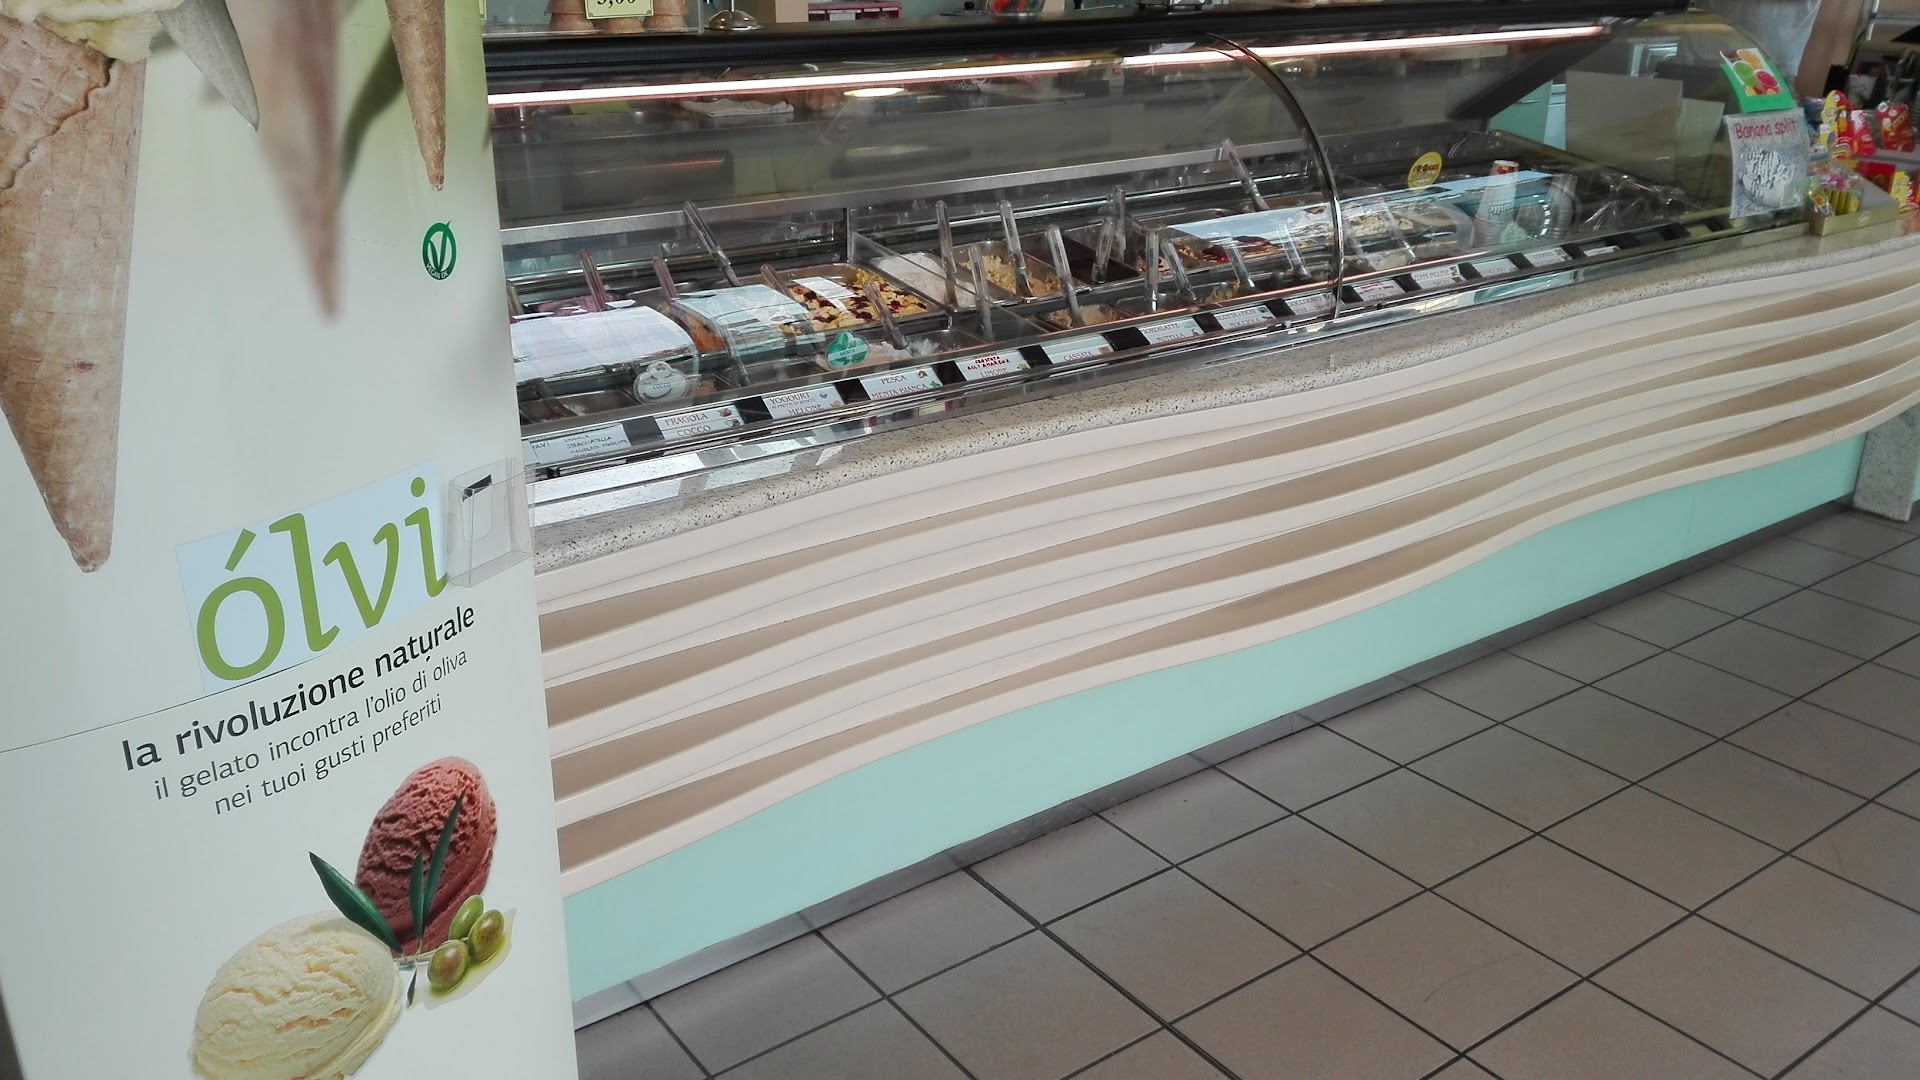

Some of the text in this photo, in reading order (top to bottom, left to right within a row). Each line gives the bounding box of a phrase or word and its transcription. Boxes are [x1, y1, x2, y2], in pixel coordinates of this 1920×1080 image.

[1735, 117, 1797, 140] Banana split
[426, 262, 441, 279] VEGAN
[1156, 332, 1186, 344] NUTELLA
[840, 348, 856, 357] MENTA
[1063, 351, 1094, 362] CASSATA
[980, 367, 1009, 378] LIMONE
[652, 381, 671, 390] COCCO
[880, 375, 908, 385] PESCA
[768, 391, 811, 405] YOGOURT
[871, 383, 929, 400] MENTA BIANCA
[787, 403, 824, 417] MELONE
[664, 412, 709, 427] FRAGOLA
[676, 424, 712, 437] COCCO
[566, 435, 612, 449] STRACCIATELLA
[121, 604, 475, 771] la rivoluzione naturale
[154, 647, 468, 801] il gelato incontra l'olio di oliva
[214, 694, 443, 815] nei tuoi gusti preferiti
